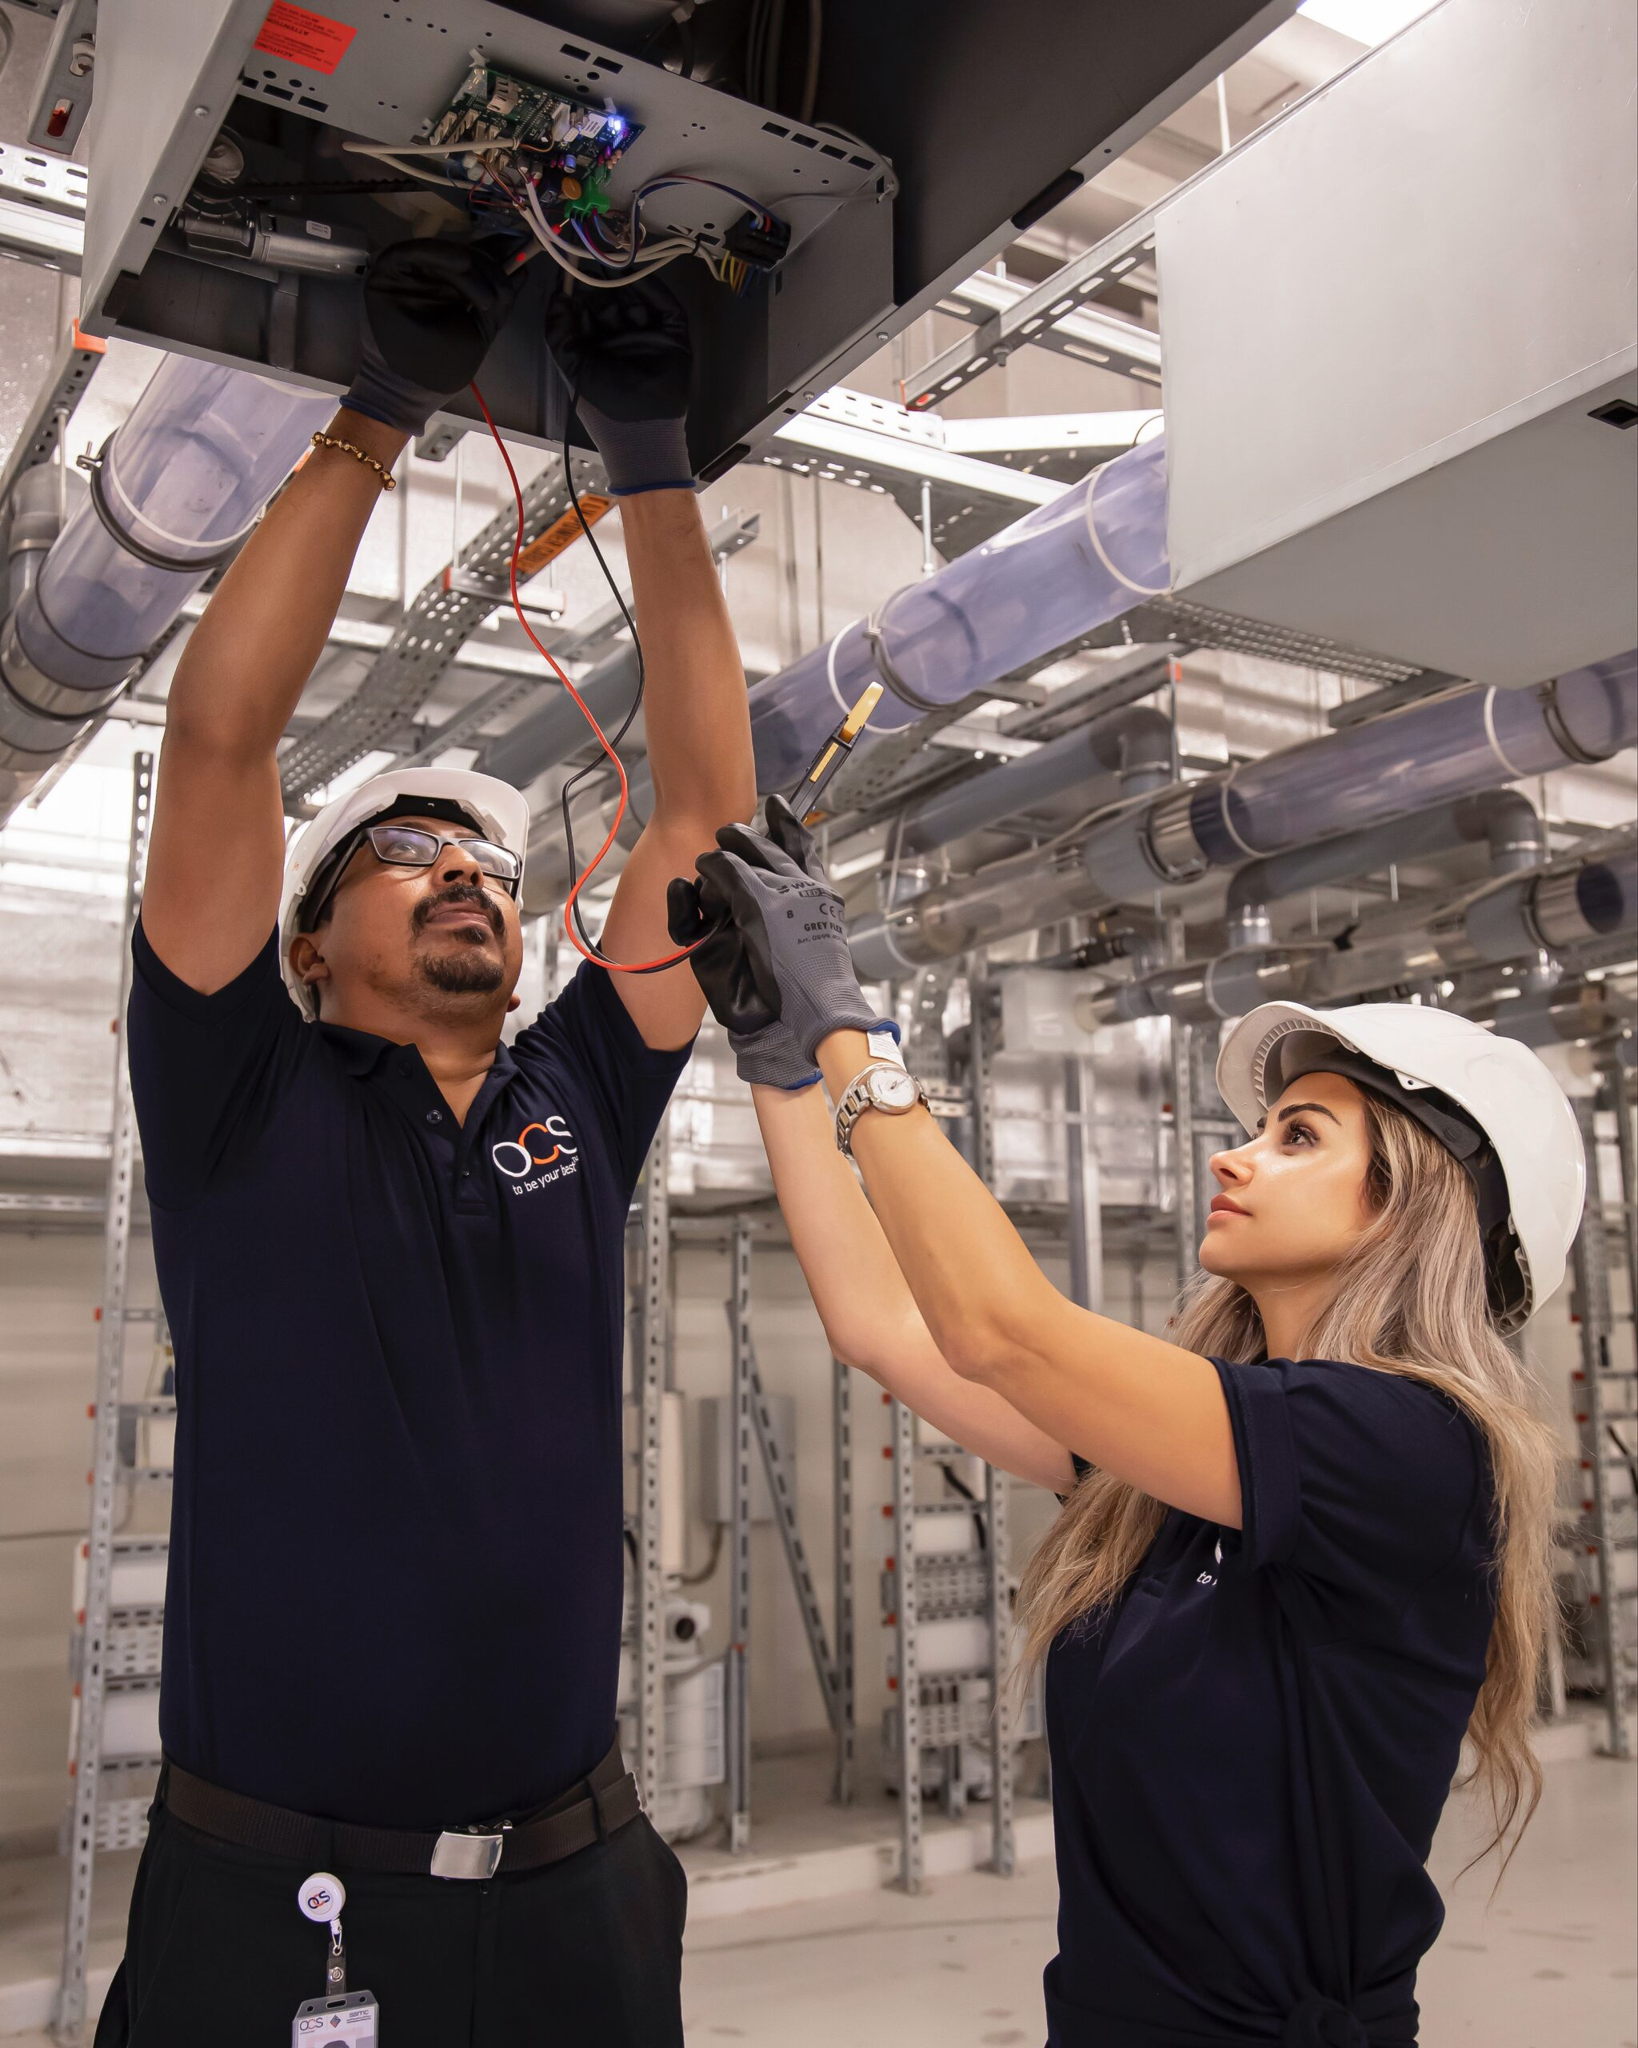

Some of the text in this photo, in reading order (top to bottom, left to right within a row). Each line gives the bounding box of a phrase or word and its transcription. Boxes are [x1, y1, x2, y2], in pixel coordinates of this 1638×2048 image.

[804, 922, 827, 931] GREY
[492, 1115, 577, 1178] OCS
[511, 1184, 523, 1195] to
[524, 1181, 540, 1192] be
[537, 1168, 560, 1189] your
[1196, 1571, 1212, 1584] to
[307, 1890, 330, 1909] OCS
[299, 2017, 324, 2031] OCS
